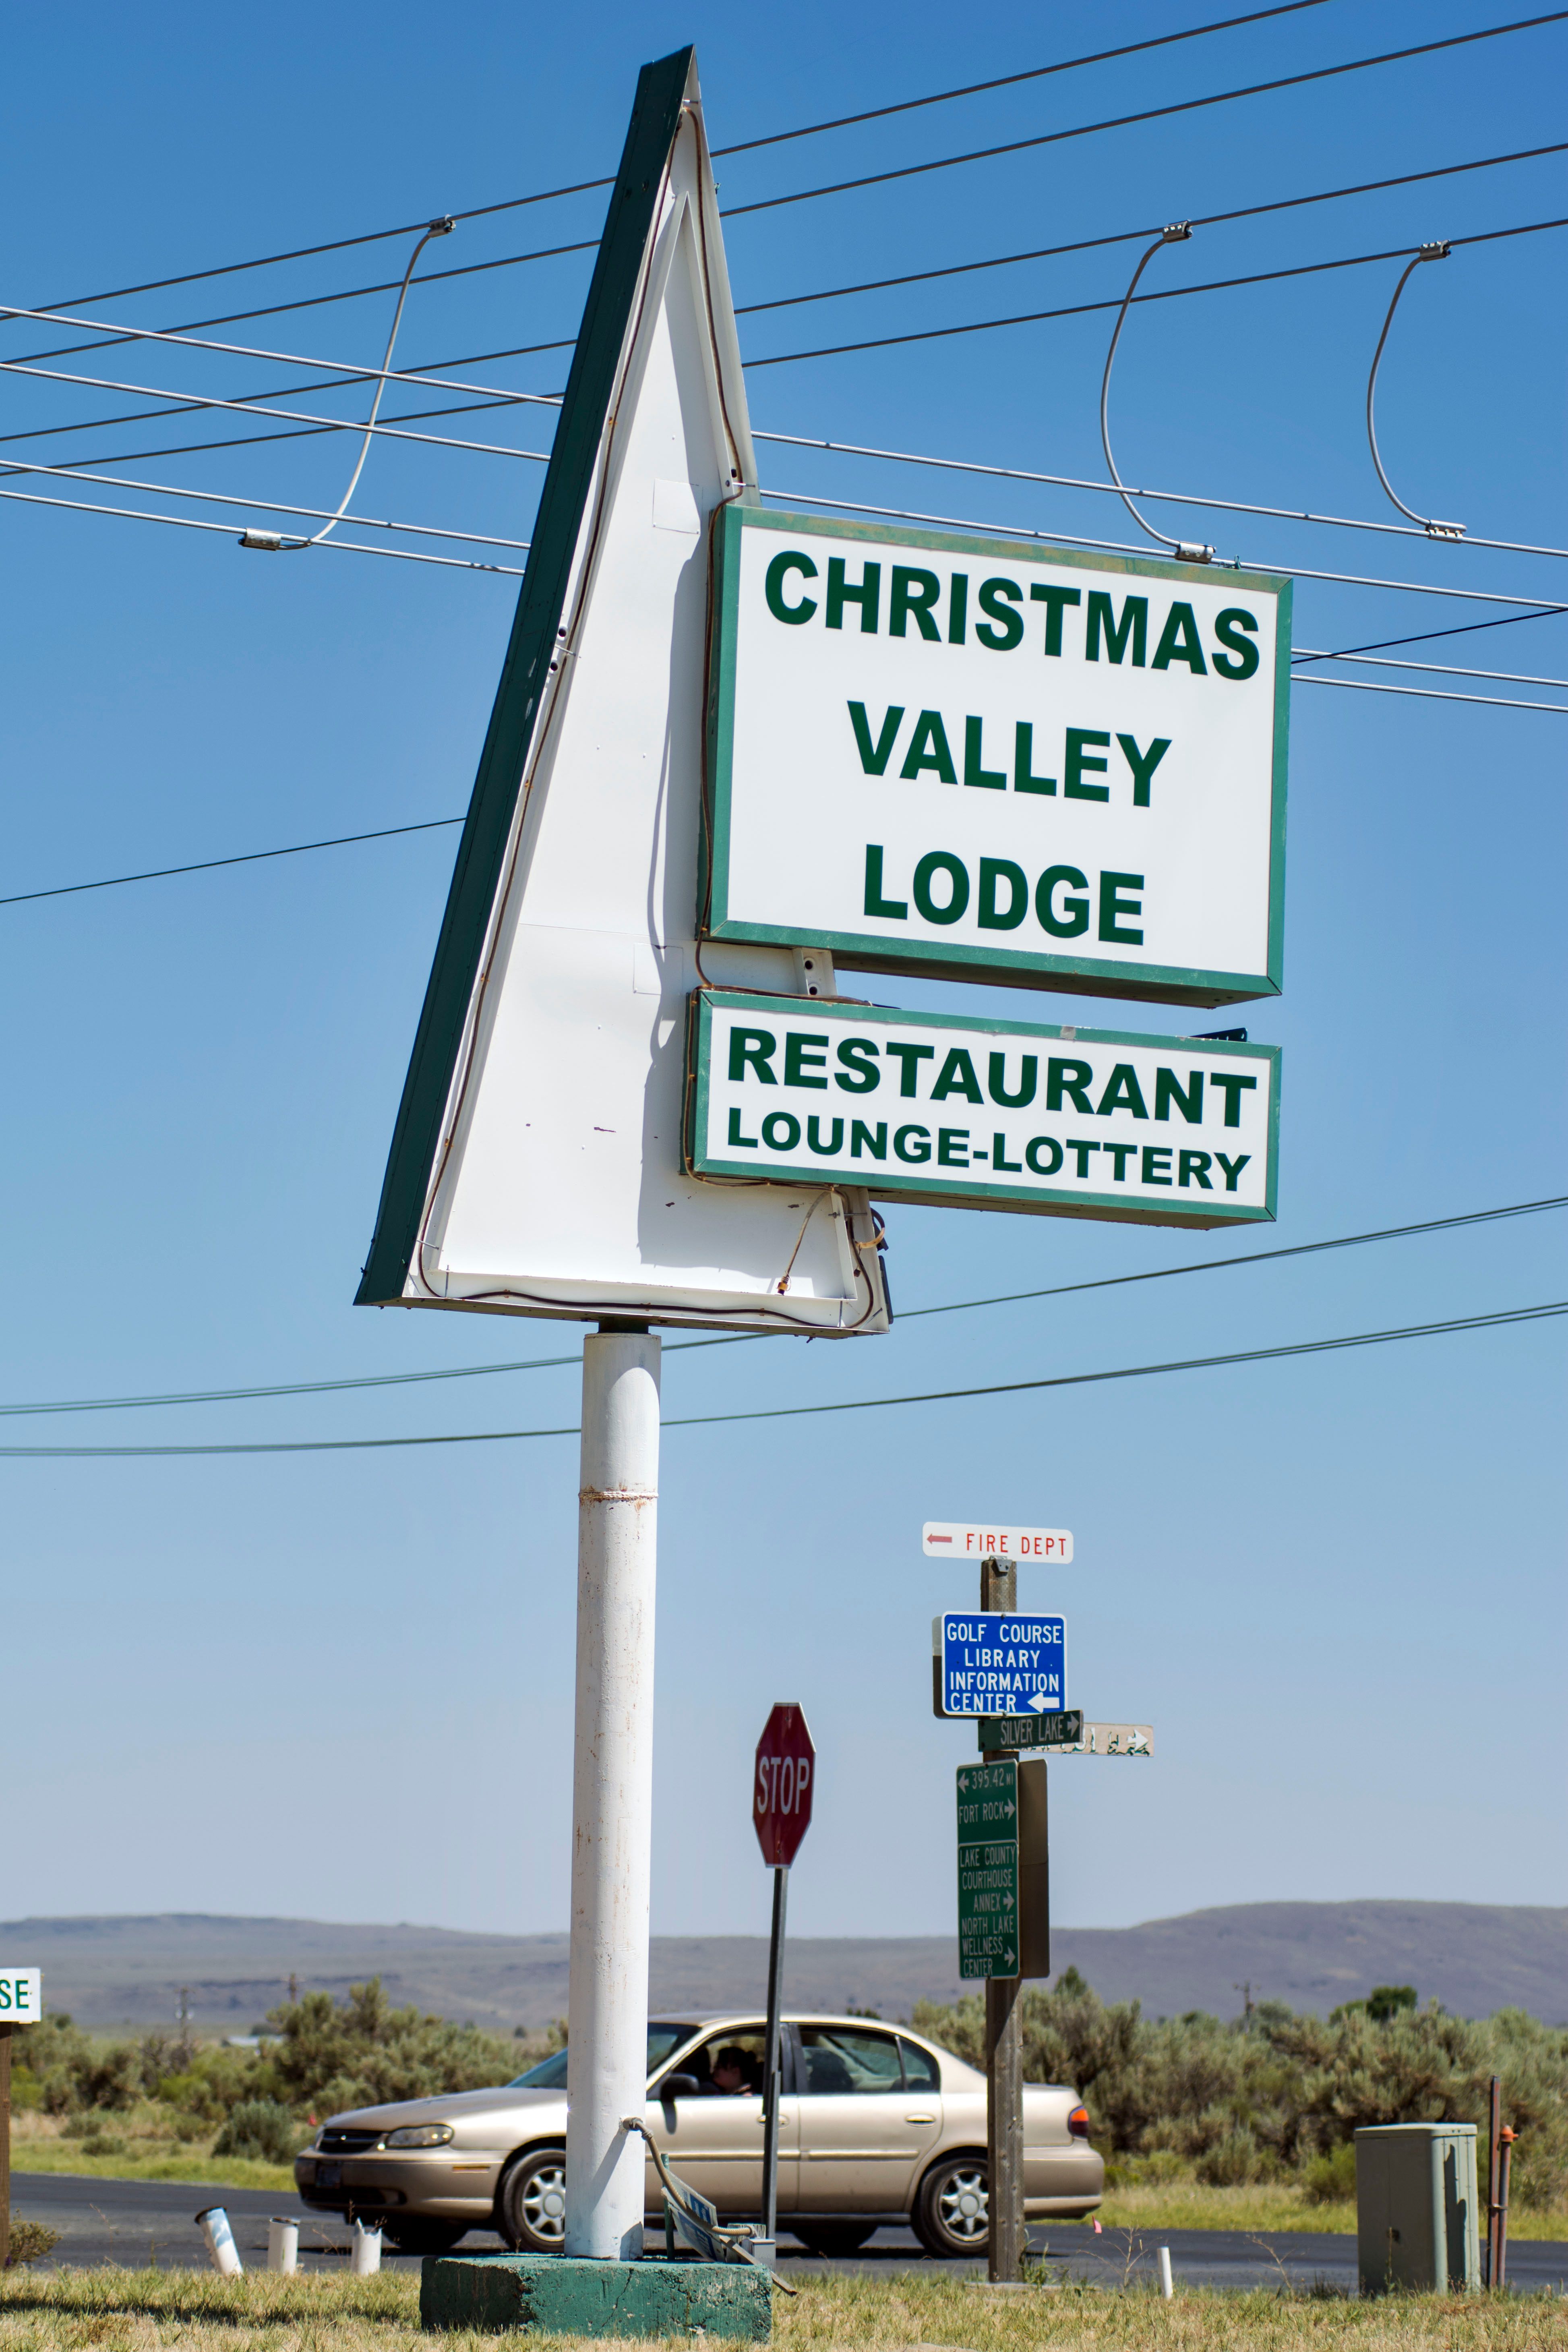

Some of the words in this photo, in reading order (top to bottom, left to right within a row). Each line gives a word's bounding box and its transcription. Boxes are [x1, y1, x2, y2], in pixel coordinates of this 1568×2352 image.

[764, 551, 1260, 681] CHRISTMAS
[846, 700, 1173, 808] VALLEY
[863, 843, 1145, 946] LODGE
[728, 1027, 1257, 1128] RESTAURANT
[728, 1108, 1252, 1192] LOUNGE-LOTTERY
[966, 1534, 1008, 1552] FIRE
[1022, 1537, 1067, 1555] DEPT
[947, 1623, 987, 1641] GOLF
[1000, 1625, 1062, 1643] COURSE
[965, 1649, 1040, 1667] LIBRARY
[950, 1673, 1059, 1692] INFORMATION
[951, 1694, 1016, 1712] CENTER
[1000, 1718, 1033, 1745] SILVER
[1038, 1715, 1064, 1742] LAKE
[757, 1756, 809, 1815] STOP
[1006, 1773, 1013, 1785] MI
[959, 1805, 979, 1823] FORT
[983, 1802, 1004, 1820] ROCK
[960, 1849, 980, 1867] LAKE
[985, 1846, 1016, 1865] COUNTY
[962, 1869, 1013, 1889] COURTHOUSE
[974, 1893, 1001, 1911] ANNEX
[962, 1917, 988, 1935] NORTH
[993, 1915, 1014, 1933] LAKE
[962, 1937, 1003, 1955] WELLNESS
[964, 1959, 993, 1977] CENTER
